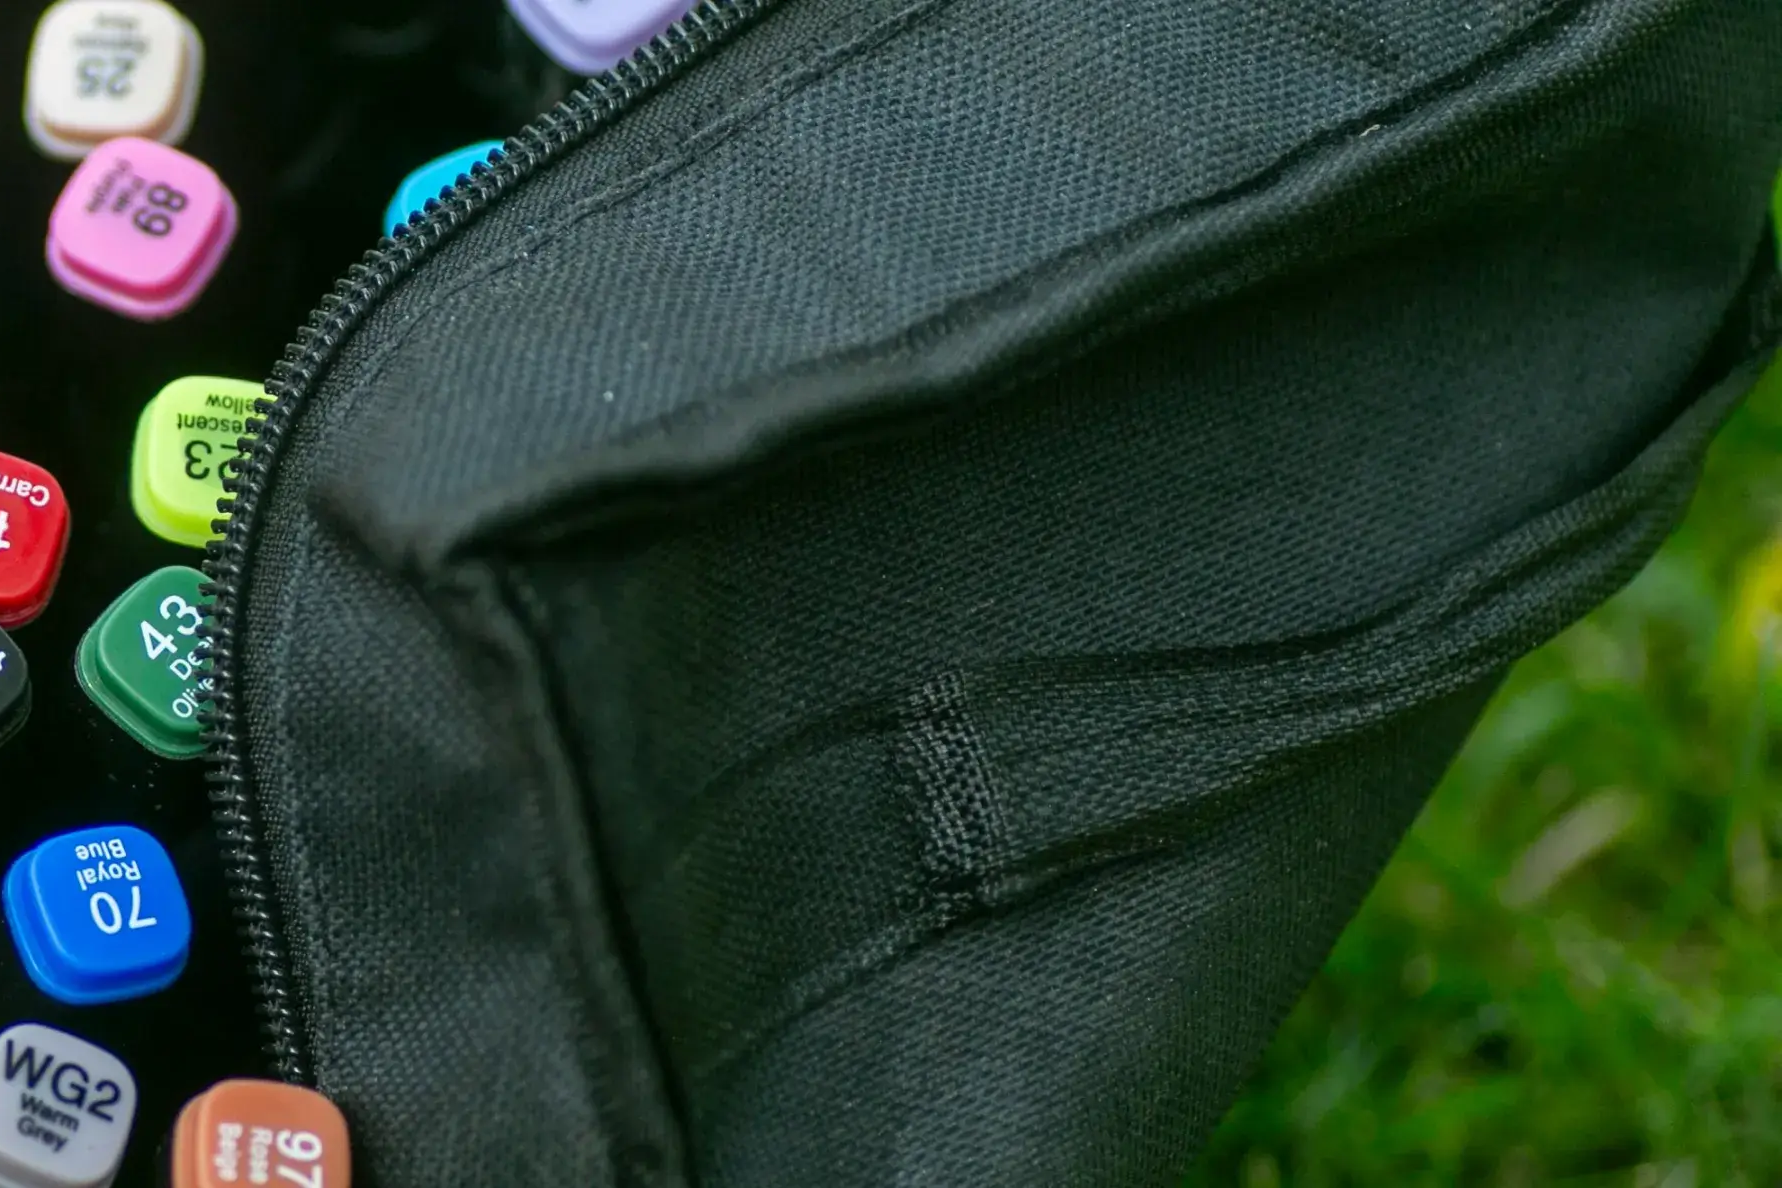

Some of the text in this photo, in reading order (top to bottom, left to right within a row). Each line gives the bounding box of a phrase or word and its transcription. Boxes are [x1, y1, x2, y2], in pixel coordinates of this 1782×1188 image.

[132, 182, 189, 238] 89
[177, 413, 246, 434] escent
[205, 393, 255, 416] ellow
[140, 595, 203, 660] 43
[74, 838, 126, 861] Blue
[76, 860, 142, 891] Royal
[90, 885, 157, 935] 70
[5, 1038, 121, 1124] WG2
[17, 1115, 69, 1153] Grey
[21, 1092, 80, 1133] Warm
[249, 1126, 273, 1185] Rose
[276, 1129, 323, 1188] 97
